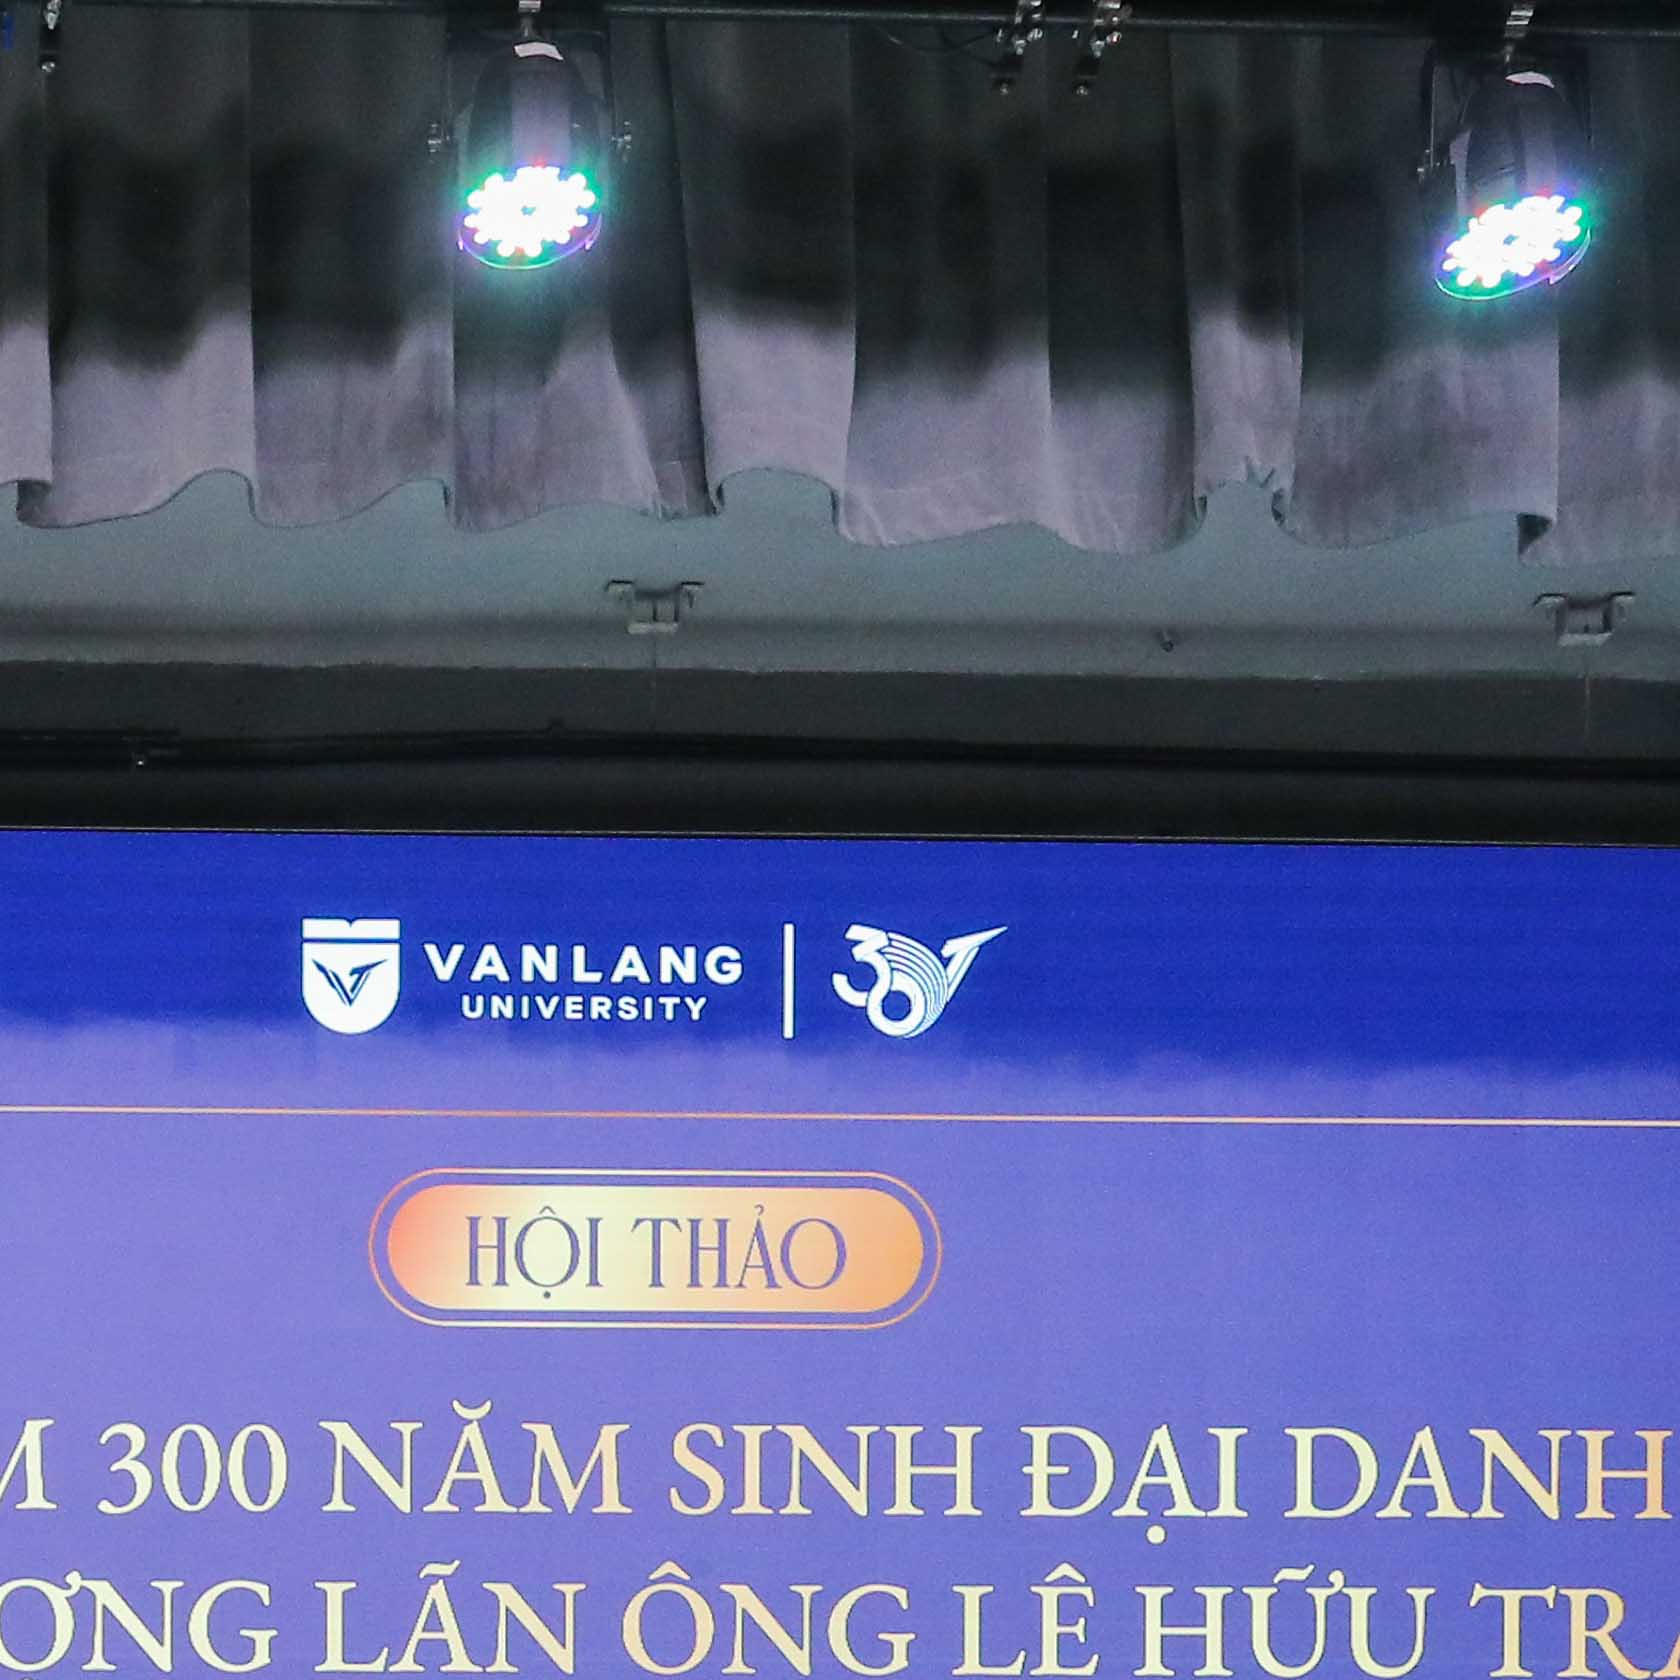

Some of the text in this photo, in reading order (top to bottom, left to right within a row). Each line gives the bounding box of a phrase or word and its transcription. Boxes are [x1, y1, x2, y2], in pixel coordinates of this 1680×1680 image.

[424, 943, 743, 985] VANLANG
[462, 994, 707, 1021] UNIVERSITY
[465, 1204, 848, 1299] HỘI THẢO
[96, 1422, 288, 1515] 300
[318, 1399, 634, 1515] NĂM
[669, 1423, 983, 1517] SINH
[1019, 1424, 1248, 1544] ĐẠI
[1283, 1425, 1674, 1521] DANH
[313, 1559, 587, 1676] LÃN
[621, 1560, 917, 1677] ÔNG
[951, 1562, 1100, 1677] LÊ
[1132, 1563, 1437, 1679] HỮU
